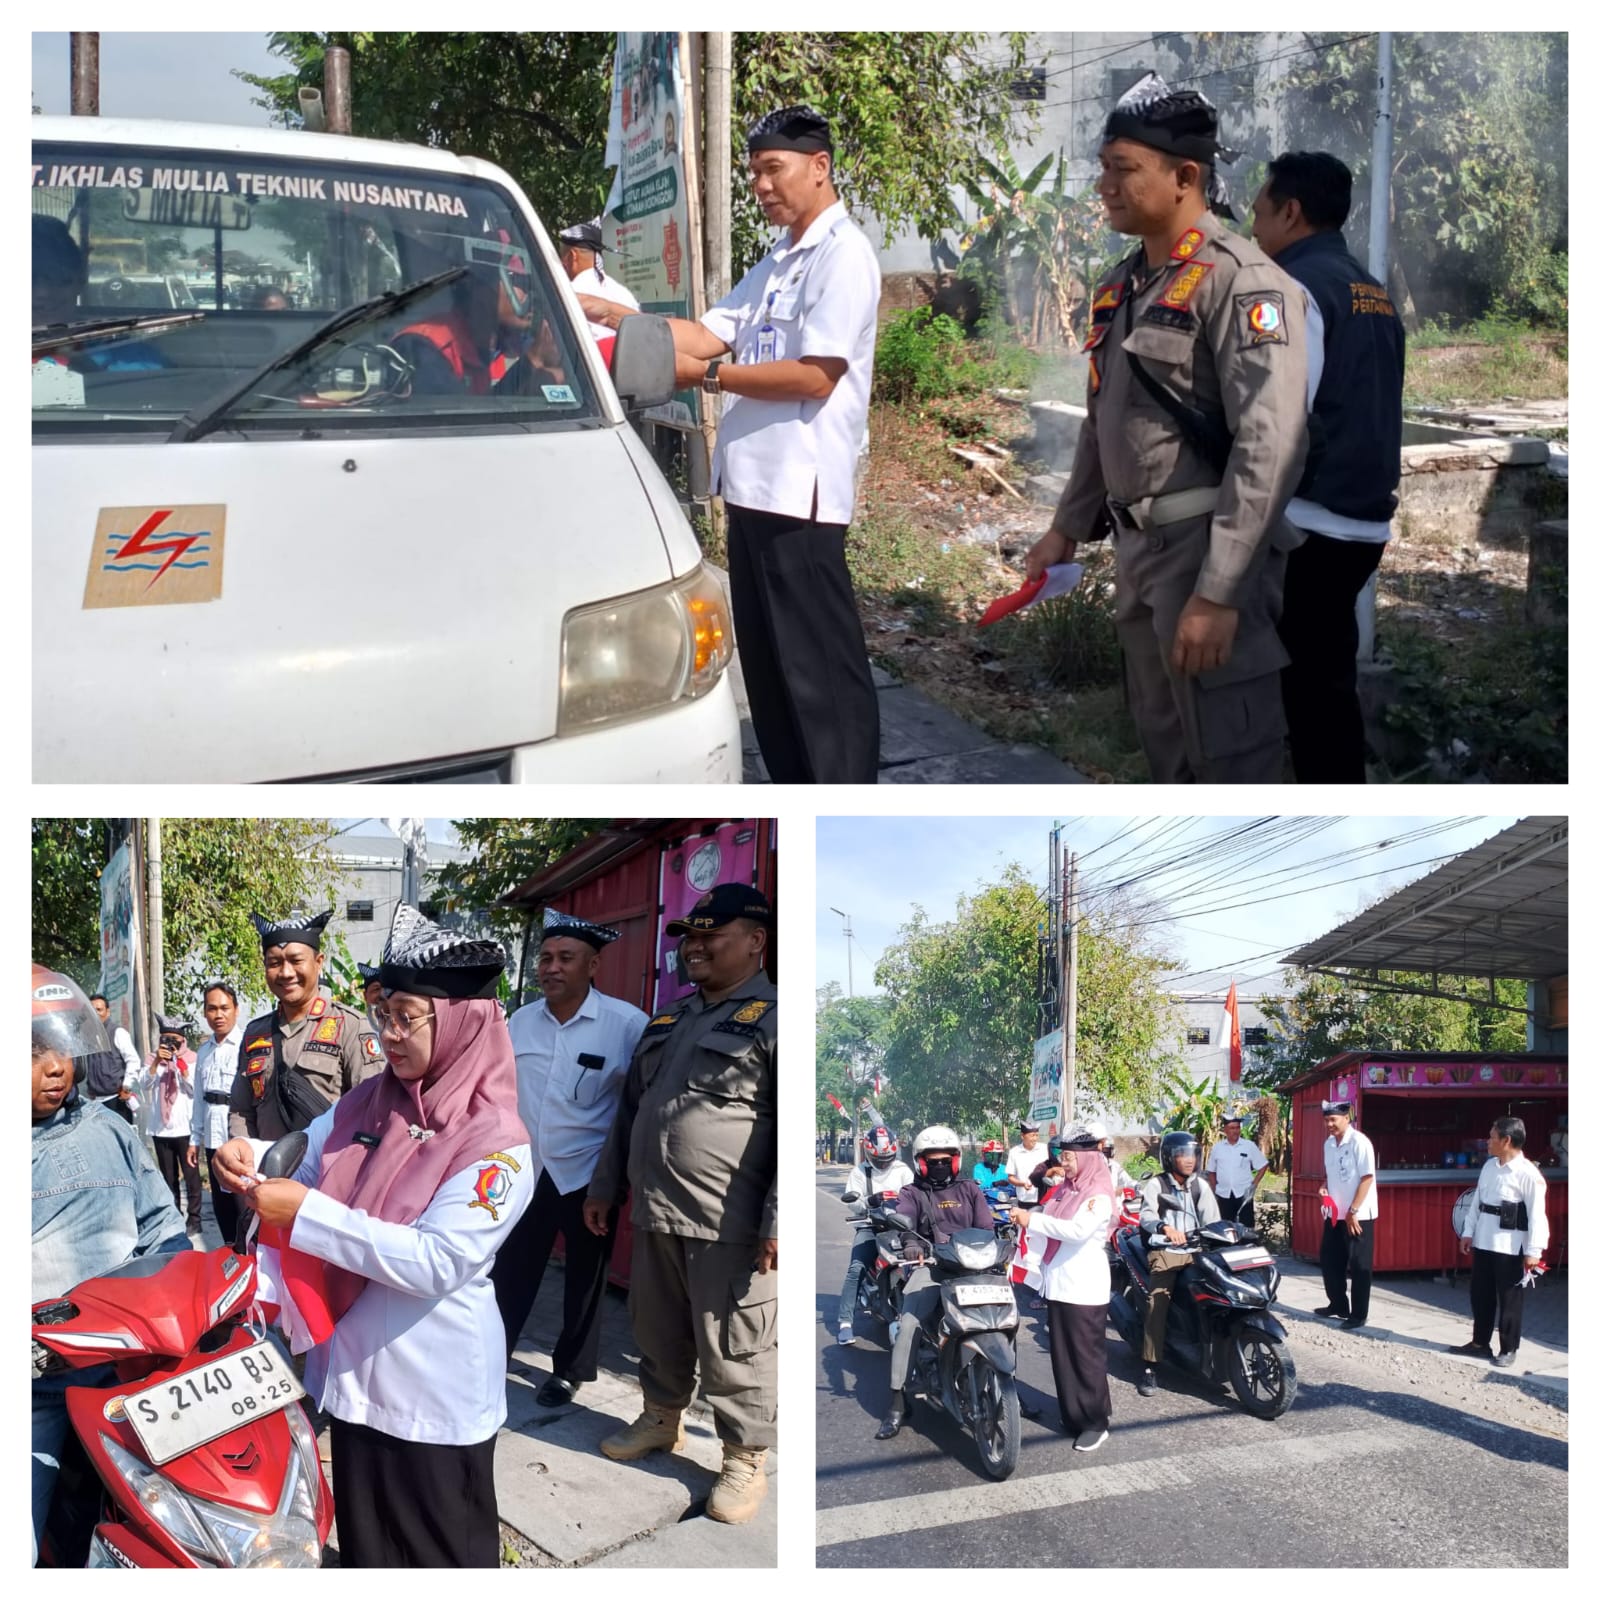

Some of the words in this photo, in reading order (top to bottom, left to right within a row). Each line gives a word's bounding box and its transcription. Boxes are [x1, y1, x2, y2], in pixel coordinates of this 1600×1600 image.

[49, 165, 144, 189] IKHLAS
[152, 168, 229, 193] MULIA
[236, 173, 327, 200] TEKNIK
[333, 181, 469, 218] NUSANTARA
[138, 1399, 159, 1423] S
[169, 1367, 233, 1411] 2140
[240, 1350, 274, 1380] BJ
